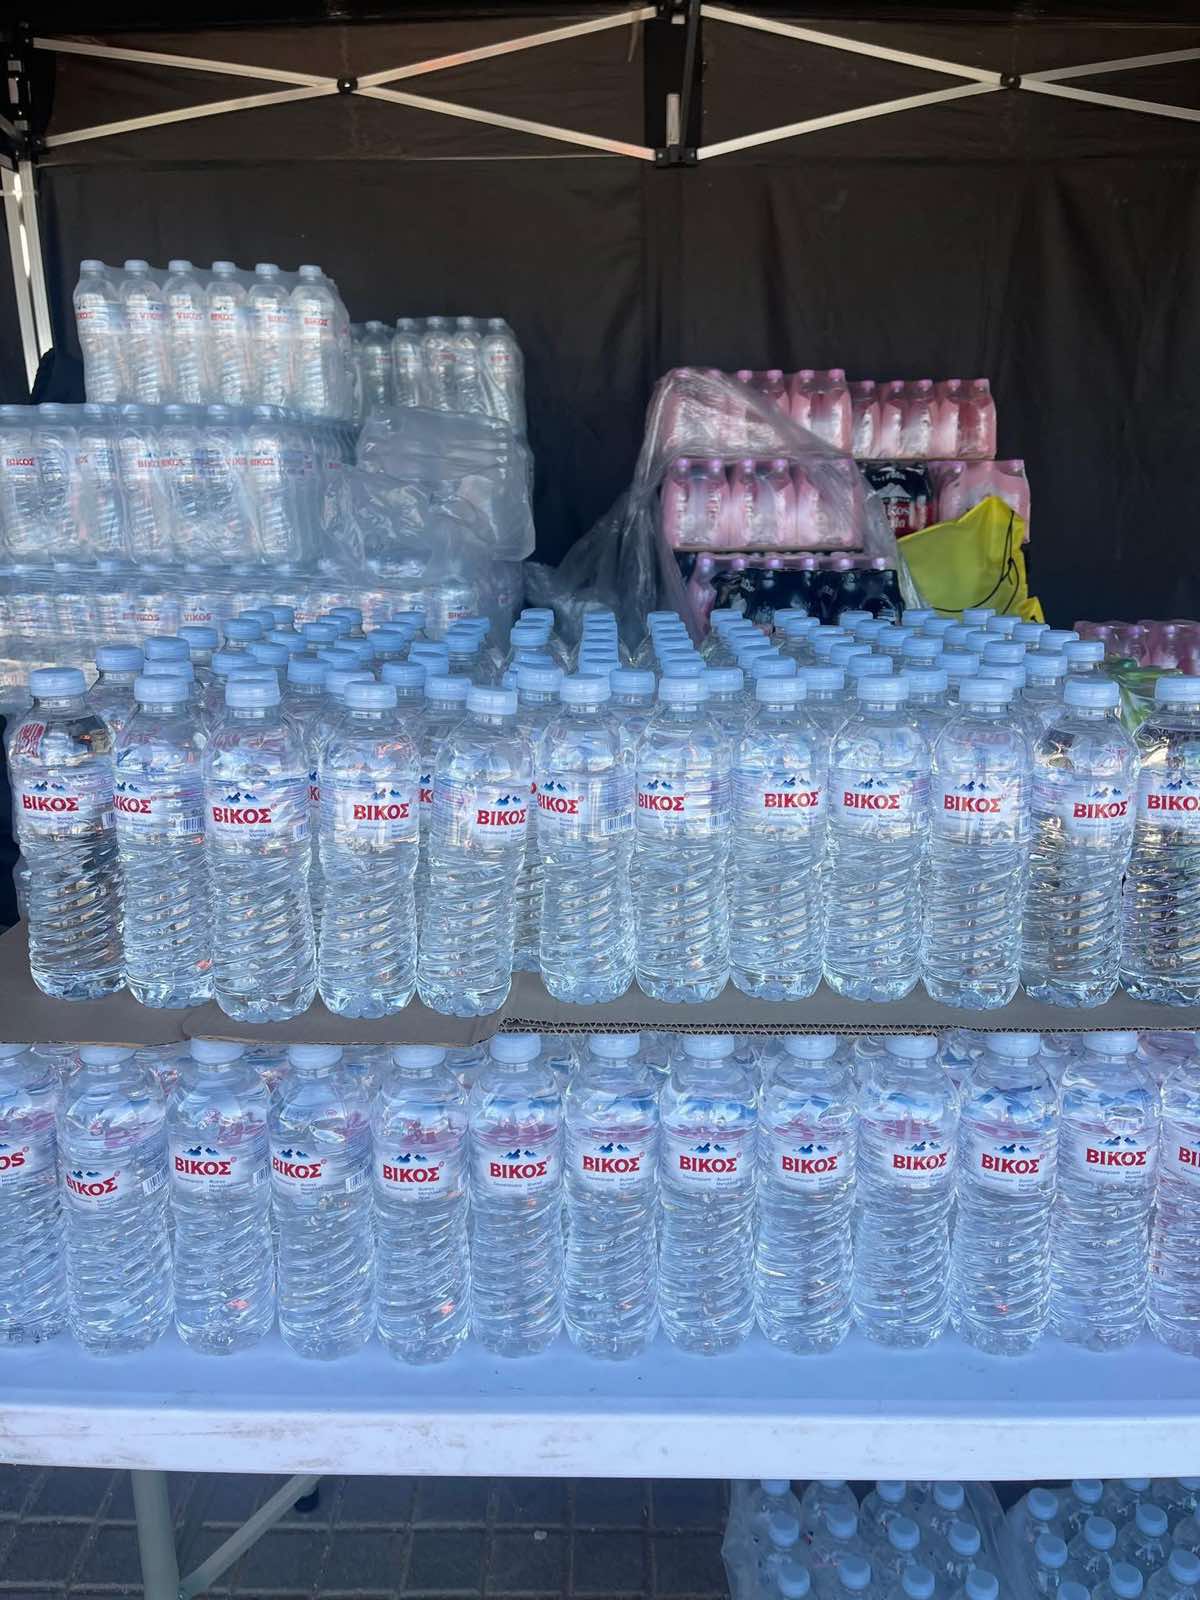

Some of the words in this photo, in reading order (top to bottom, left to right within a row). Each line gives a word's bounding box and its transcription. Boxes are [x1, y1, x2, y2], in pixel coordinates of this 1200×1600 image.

[22, 794, 79, 812] ΒΙΚΟΣ
[537, 793, 579, 814] ΒΙΚΟΣ
[638, 792, 685, 811] ΒΙΚΟΣ
[764, 791, 819, 809] ΒΙΚΟΣ
[843, 792, 900, 810] ΒΙΚΟΣ
[944, 794, 1000, 813] ΒΙΚΟΣ
[1147, 795, 1200, 811] ΒΙΚΟ
[212, 806, 272, 825] ΒΙΚΟΣ
[353, 803, 409, 820] ΒΙΚΟΣ
[476, 809, 526, 826] ΒΙΚΟΣ
[1073, 801, 1128, 819] ΒΙΚΟΣ
[175, 1156, 231, 1176] ΒΙΚΟΣ
[583, 1155, 640, 1173] ΒΙΚΟΣ
[679, 1155, 737, 1173] ΒΙΚΟΣ
[782, 1156, 838, 1174] ΒΙΚΟΣ
[893, 1152, 947, 1170] ΒΙΚΟΣ
[981, 1153, 1039, 1174] ΒΙΚΟΣ
[1086, 1148, 1146, 1166] ΒΙΚΟΣ
[272, 1156, 322, 1180] ΒΙΚΟΣ
[383, 1165, 440, 1183] ΒΙΚΟΣ
[489, 1161, 547, 1179] ΒΙΚΟΣ
[66, 1175, 118, 1196] ΒΙΚΟΣ
